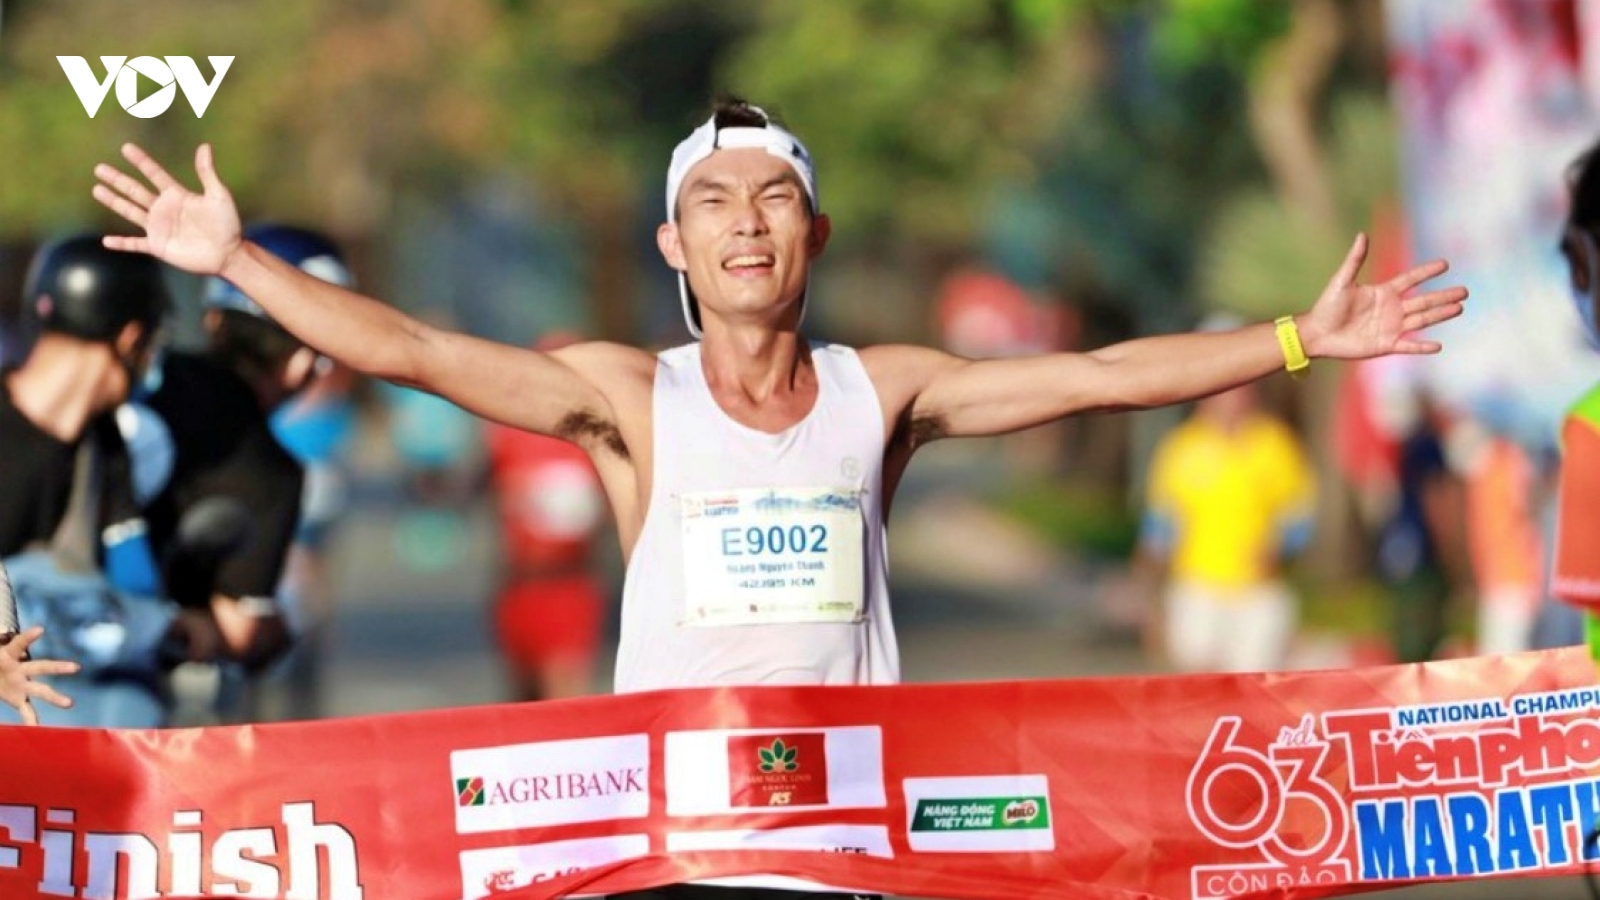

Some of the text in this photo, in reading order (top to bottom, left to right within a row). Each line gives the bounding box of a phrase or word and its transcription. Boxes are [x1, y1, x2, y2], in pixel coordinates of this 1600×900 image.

[721, 525, 829, 555] E9002
[791, 577, 815, 587] KM
[1398, 702, 1508, 726] NATIONAL
[489, 767, 644, 806] AGRIBANK
[963, 816, 994, 828] NAM
